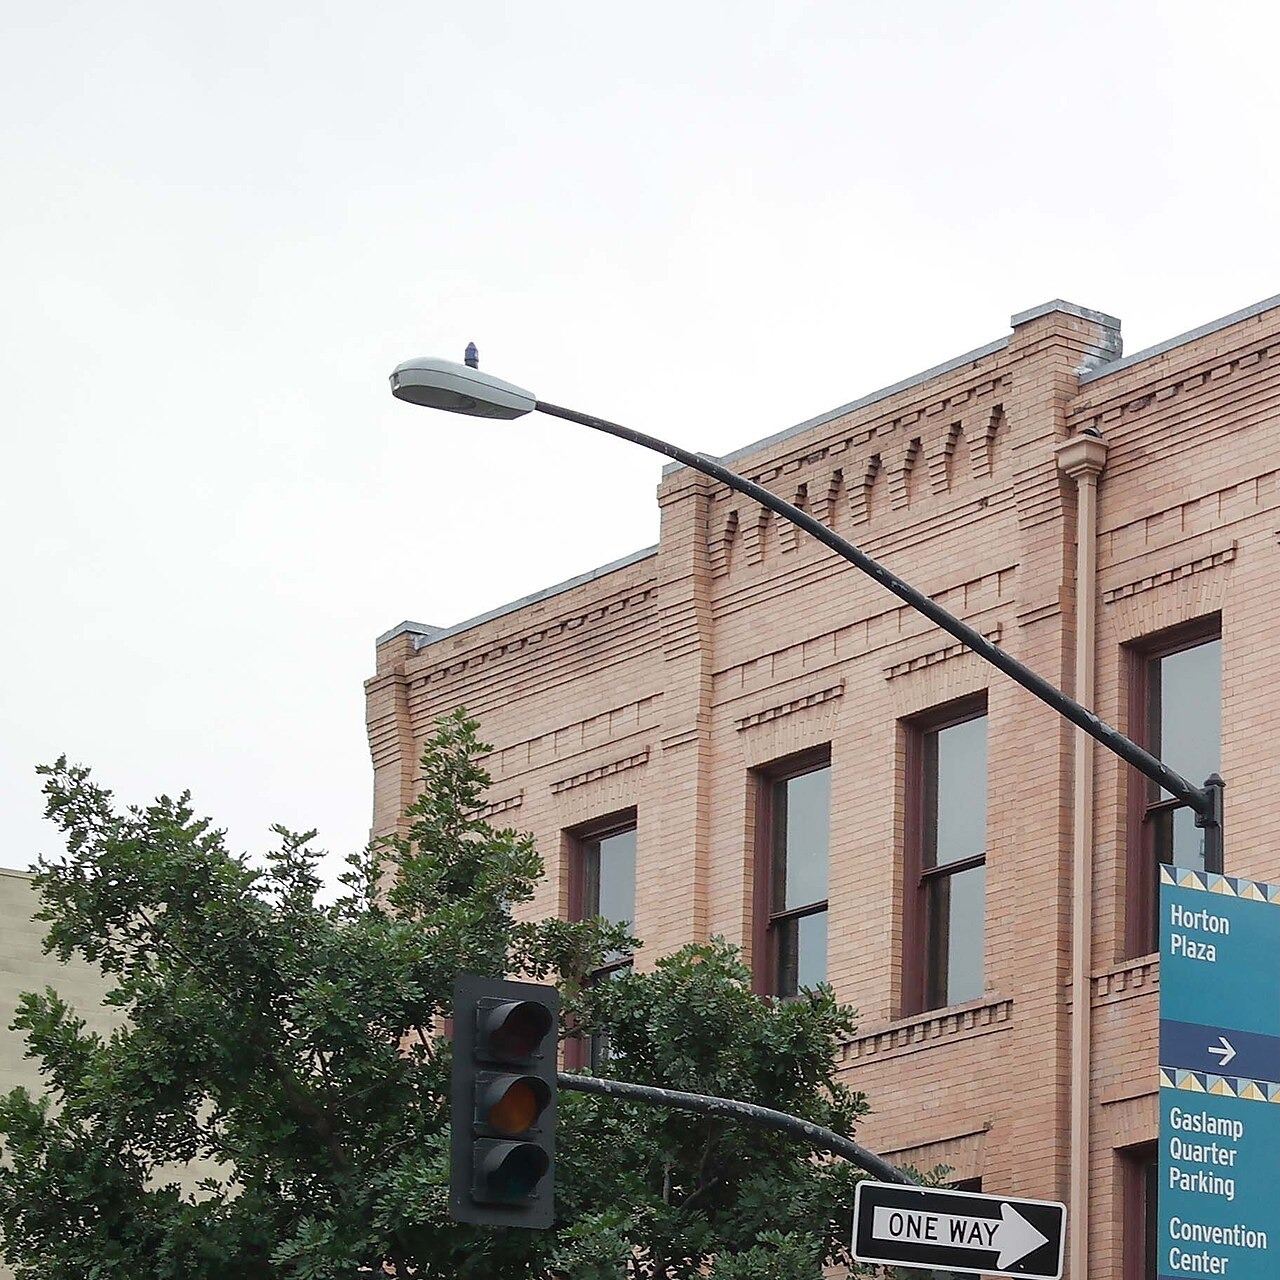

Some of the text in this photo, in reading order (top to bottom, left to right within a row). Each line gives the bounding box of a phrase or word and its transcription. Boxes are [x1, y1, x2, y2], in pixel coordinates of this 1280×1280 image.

[1170, 903, 1231, 936] Horton
[1170, 933, 1217, 963] Plaza
[1169, 1106, 1244, 1142] Gaslamp
[1169, 1137, 1237, 1167] Quarter
[1169, 1166, 1235, 1201] Parking
[889, 1212, 1000, 1247] ONE WAY
[1169, 1216, 1268, 1250] Convention
[1169, 1247, 1229, 1275] Center
